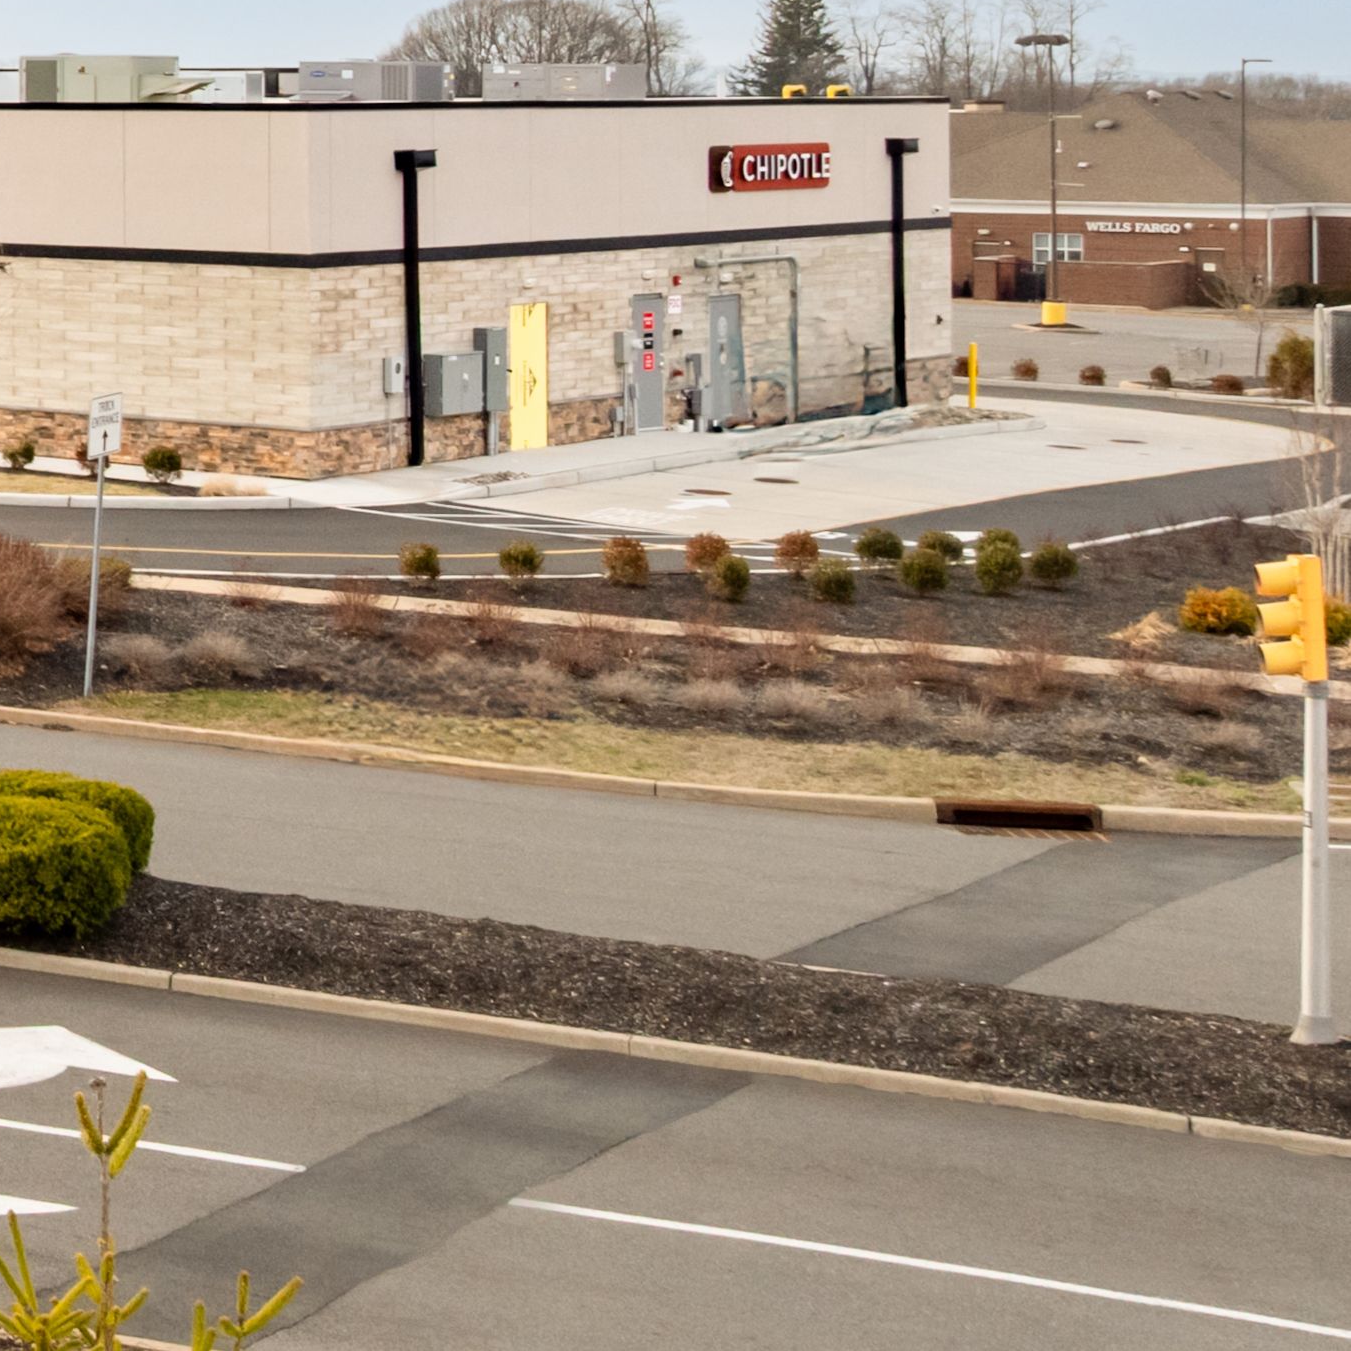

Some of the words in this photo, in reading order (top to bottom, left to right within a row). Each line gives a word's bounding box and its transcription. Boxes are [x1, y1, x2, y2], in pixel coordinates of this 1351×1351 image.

[742, 152, 832, 182] CHIPOTLE
[1085, 221, 1132, 234] WELLS
[1134, 222, 1181, 235] FARGO
